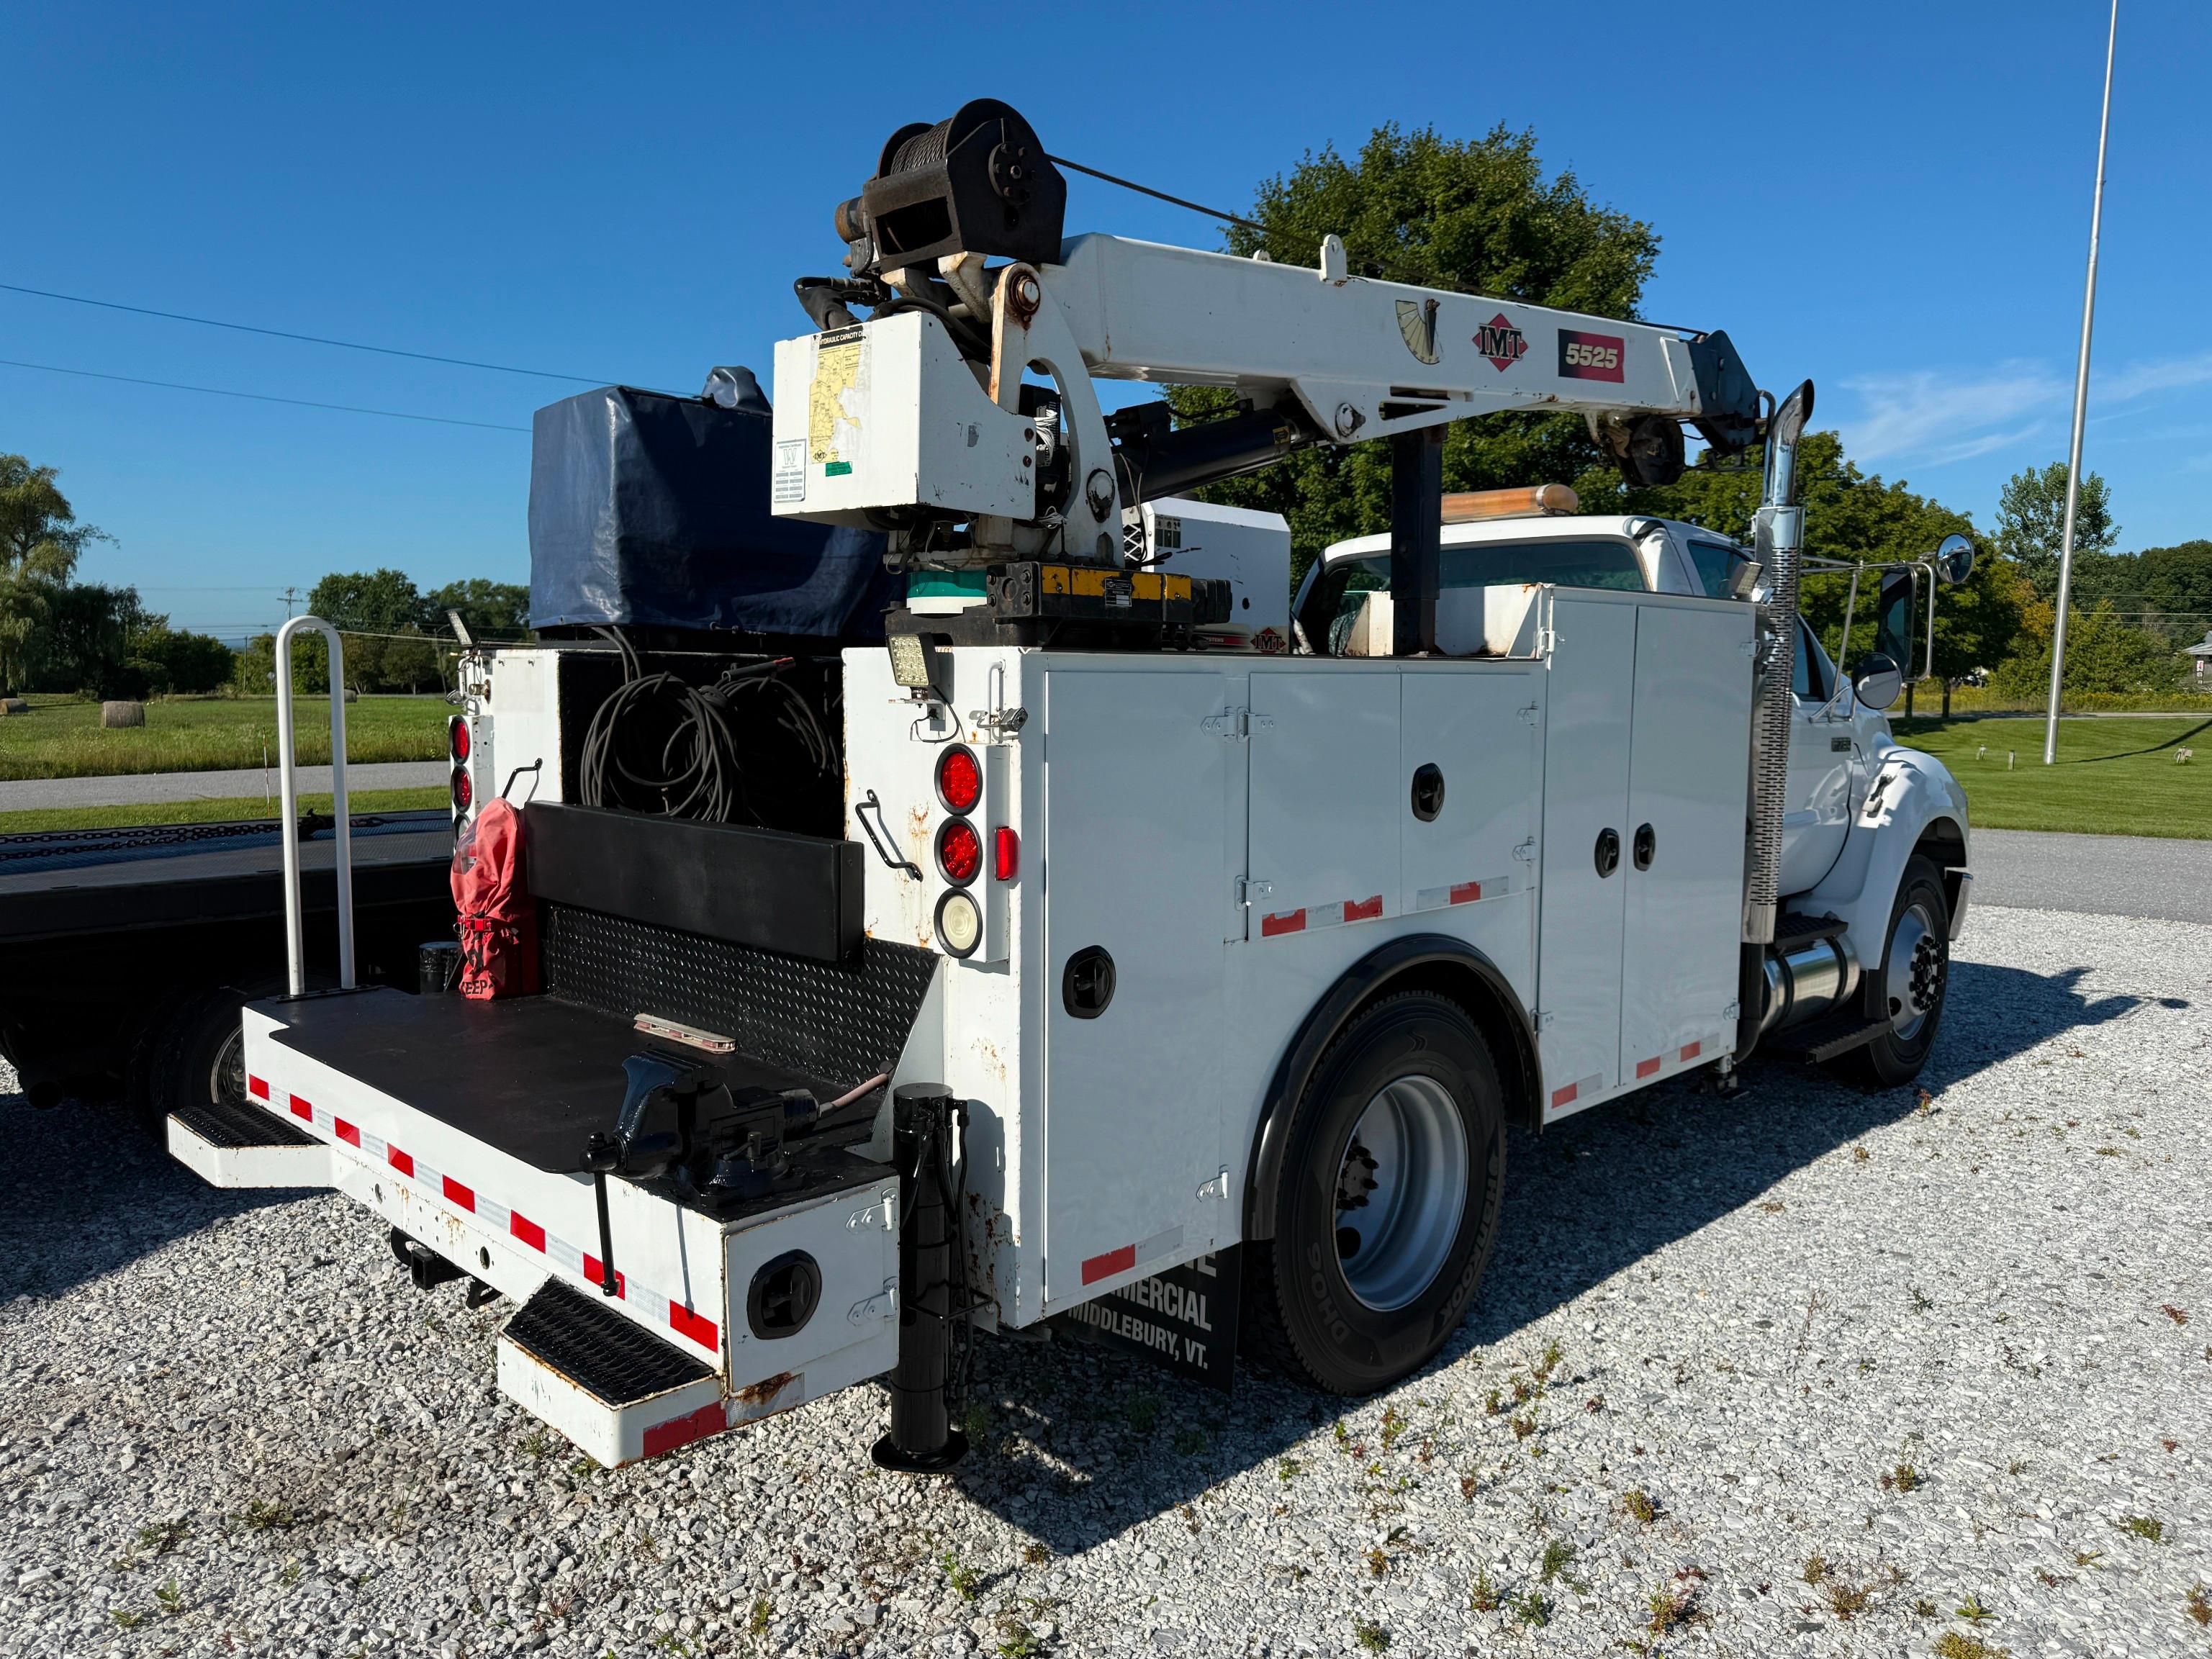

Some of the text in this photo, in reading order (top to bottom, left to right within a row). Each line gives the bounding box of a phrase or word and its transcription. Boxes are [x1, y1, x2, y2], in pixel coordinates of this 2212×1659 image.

[840, 331, 858, 341] CAPACITY
[1478, 323, 1522, 361] IMT
[1565, 343, 1618, 370] 5525
[814, 451, 826, 460] IMT
[1255, 634, 1282, 650] IMT
[1184, 1337, 1209, 1370] VT.
